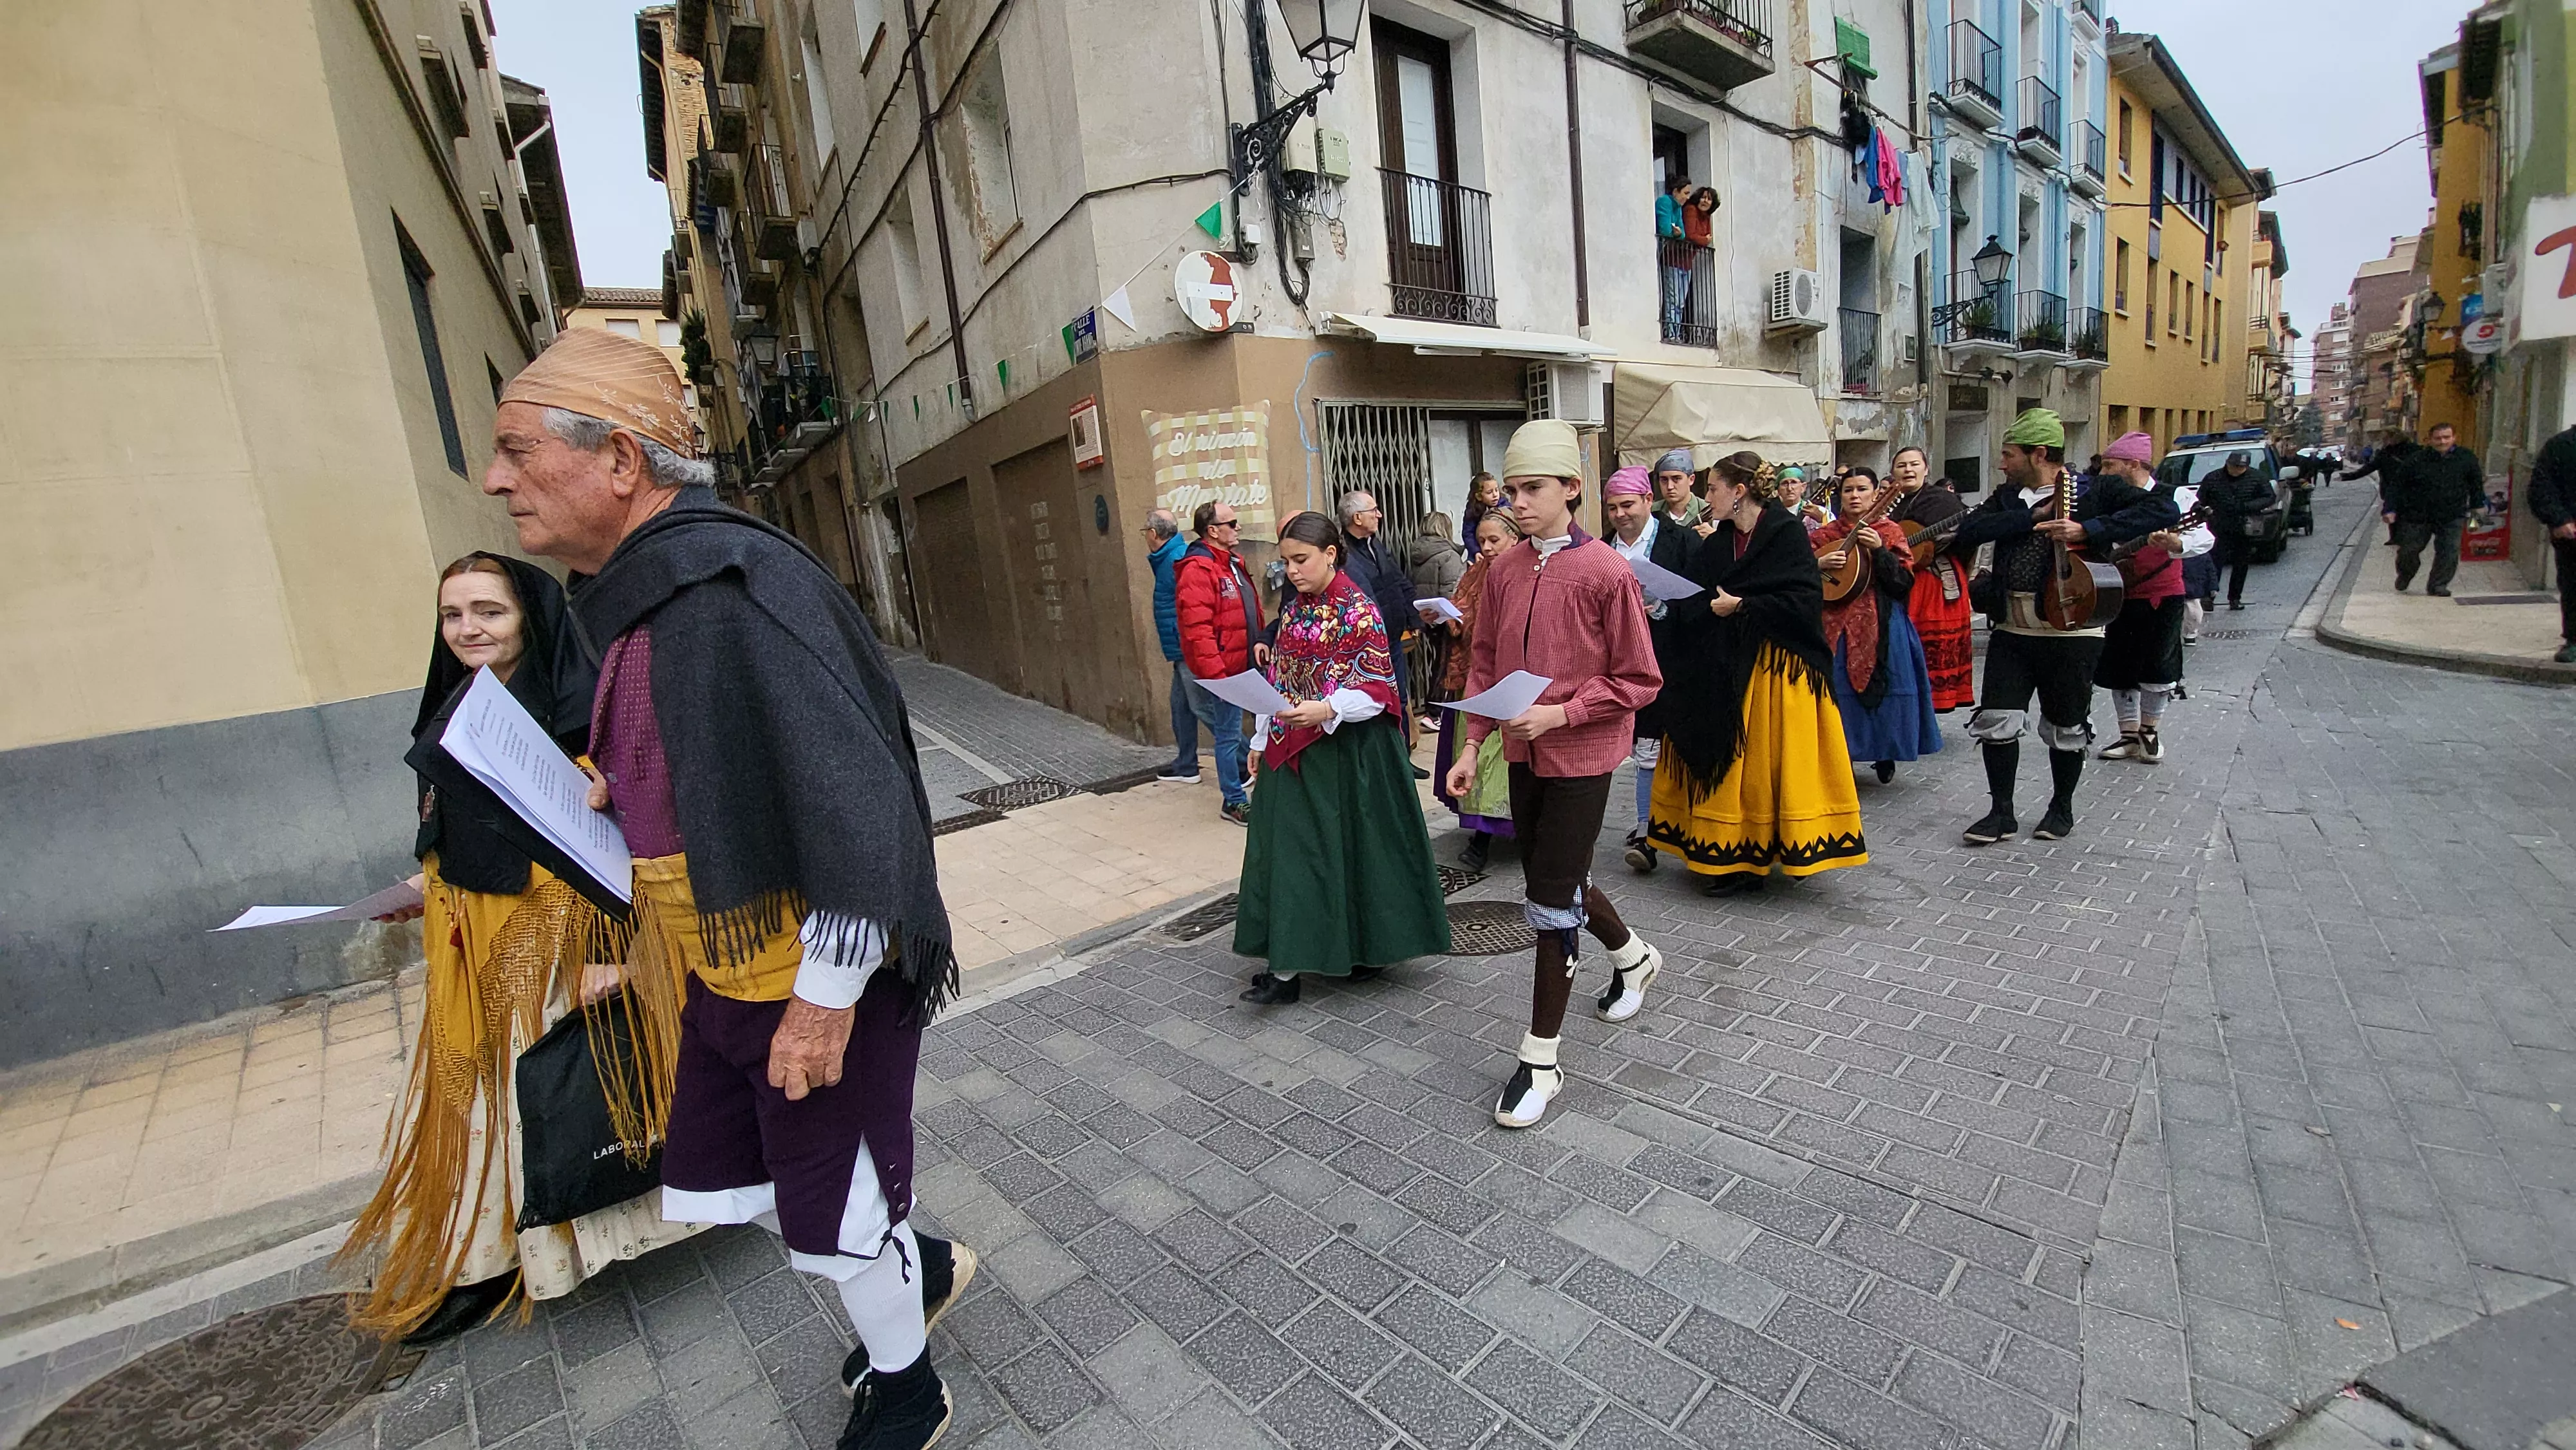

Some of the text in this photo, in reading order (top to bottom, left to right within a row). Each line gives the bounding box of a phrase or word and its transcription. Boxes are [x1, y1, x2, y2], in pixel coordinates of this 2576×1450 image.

[1074, 314, 1090, 332] CALLE
[1168, 431, 1193, 457] El
[1203, 458, 1228, 480] de
